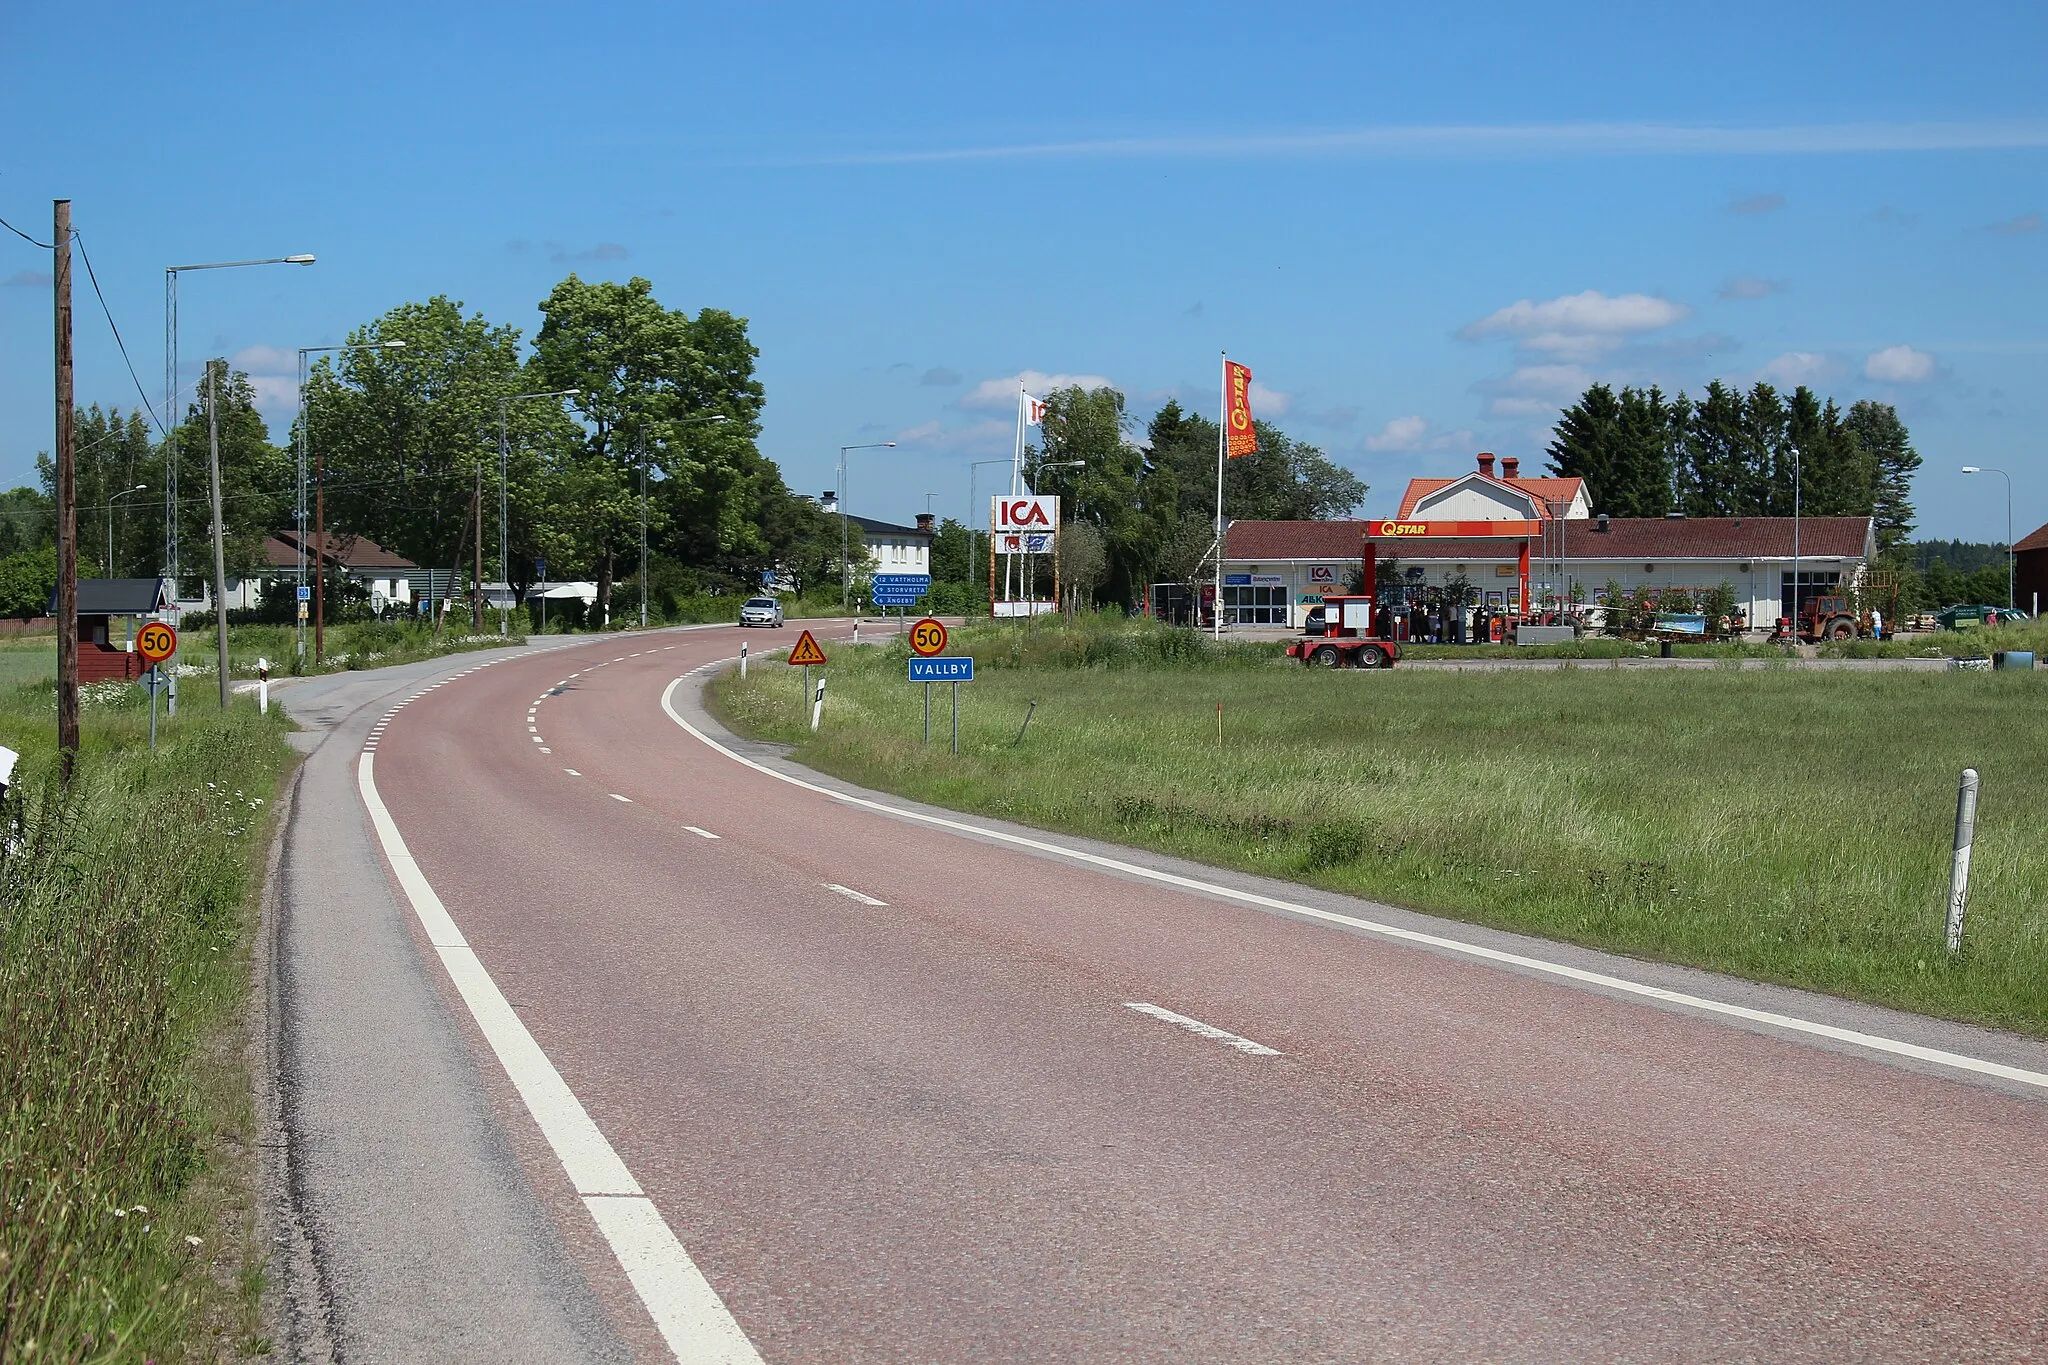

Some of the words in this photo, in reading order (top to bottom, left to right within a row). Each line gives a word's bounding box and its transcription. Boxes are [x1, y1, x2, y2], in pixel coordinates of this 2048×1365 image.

[1001, 501, 1050, 526] ICA
[1311, 567, 1332, 578] ICA
[1319, 585, 1333, 594] ICA
[143, 632, 171, 652] 50
[916, 628, 942, 647] 50
[914, 664, 968, 675] VALLBY
